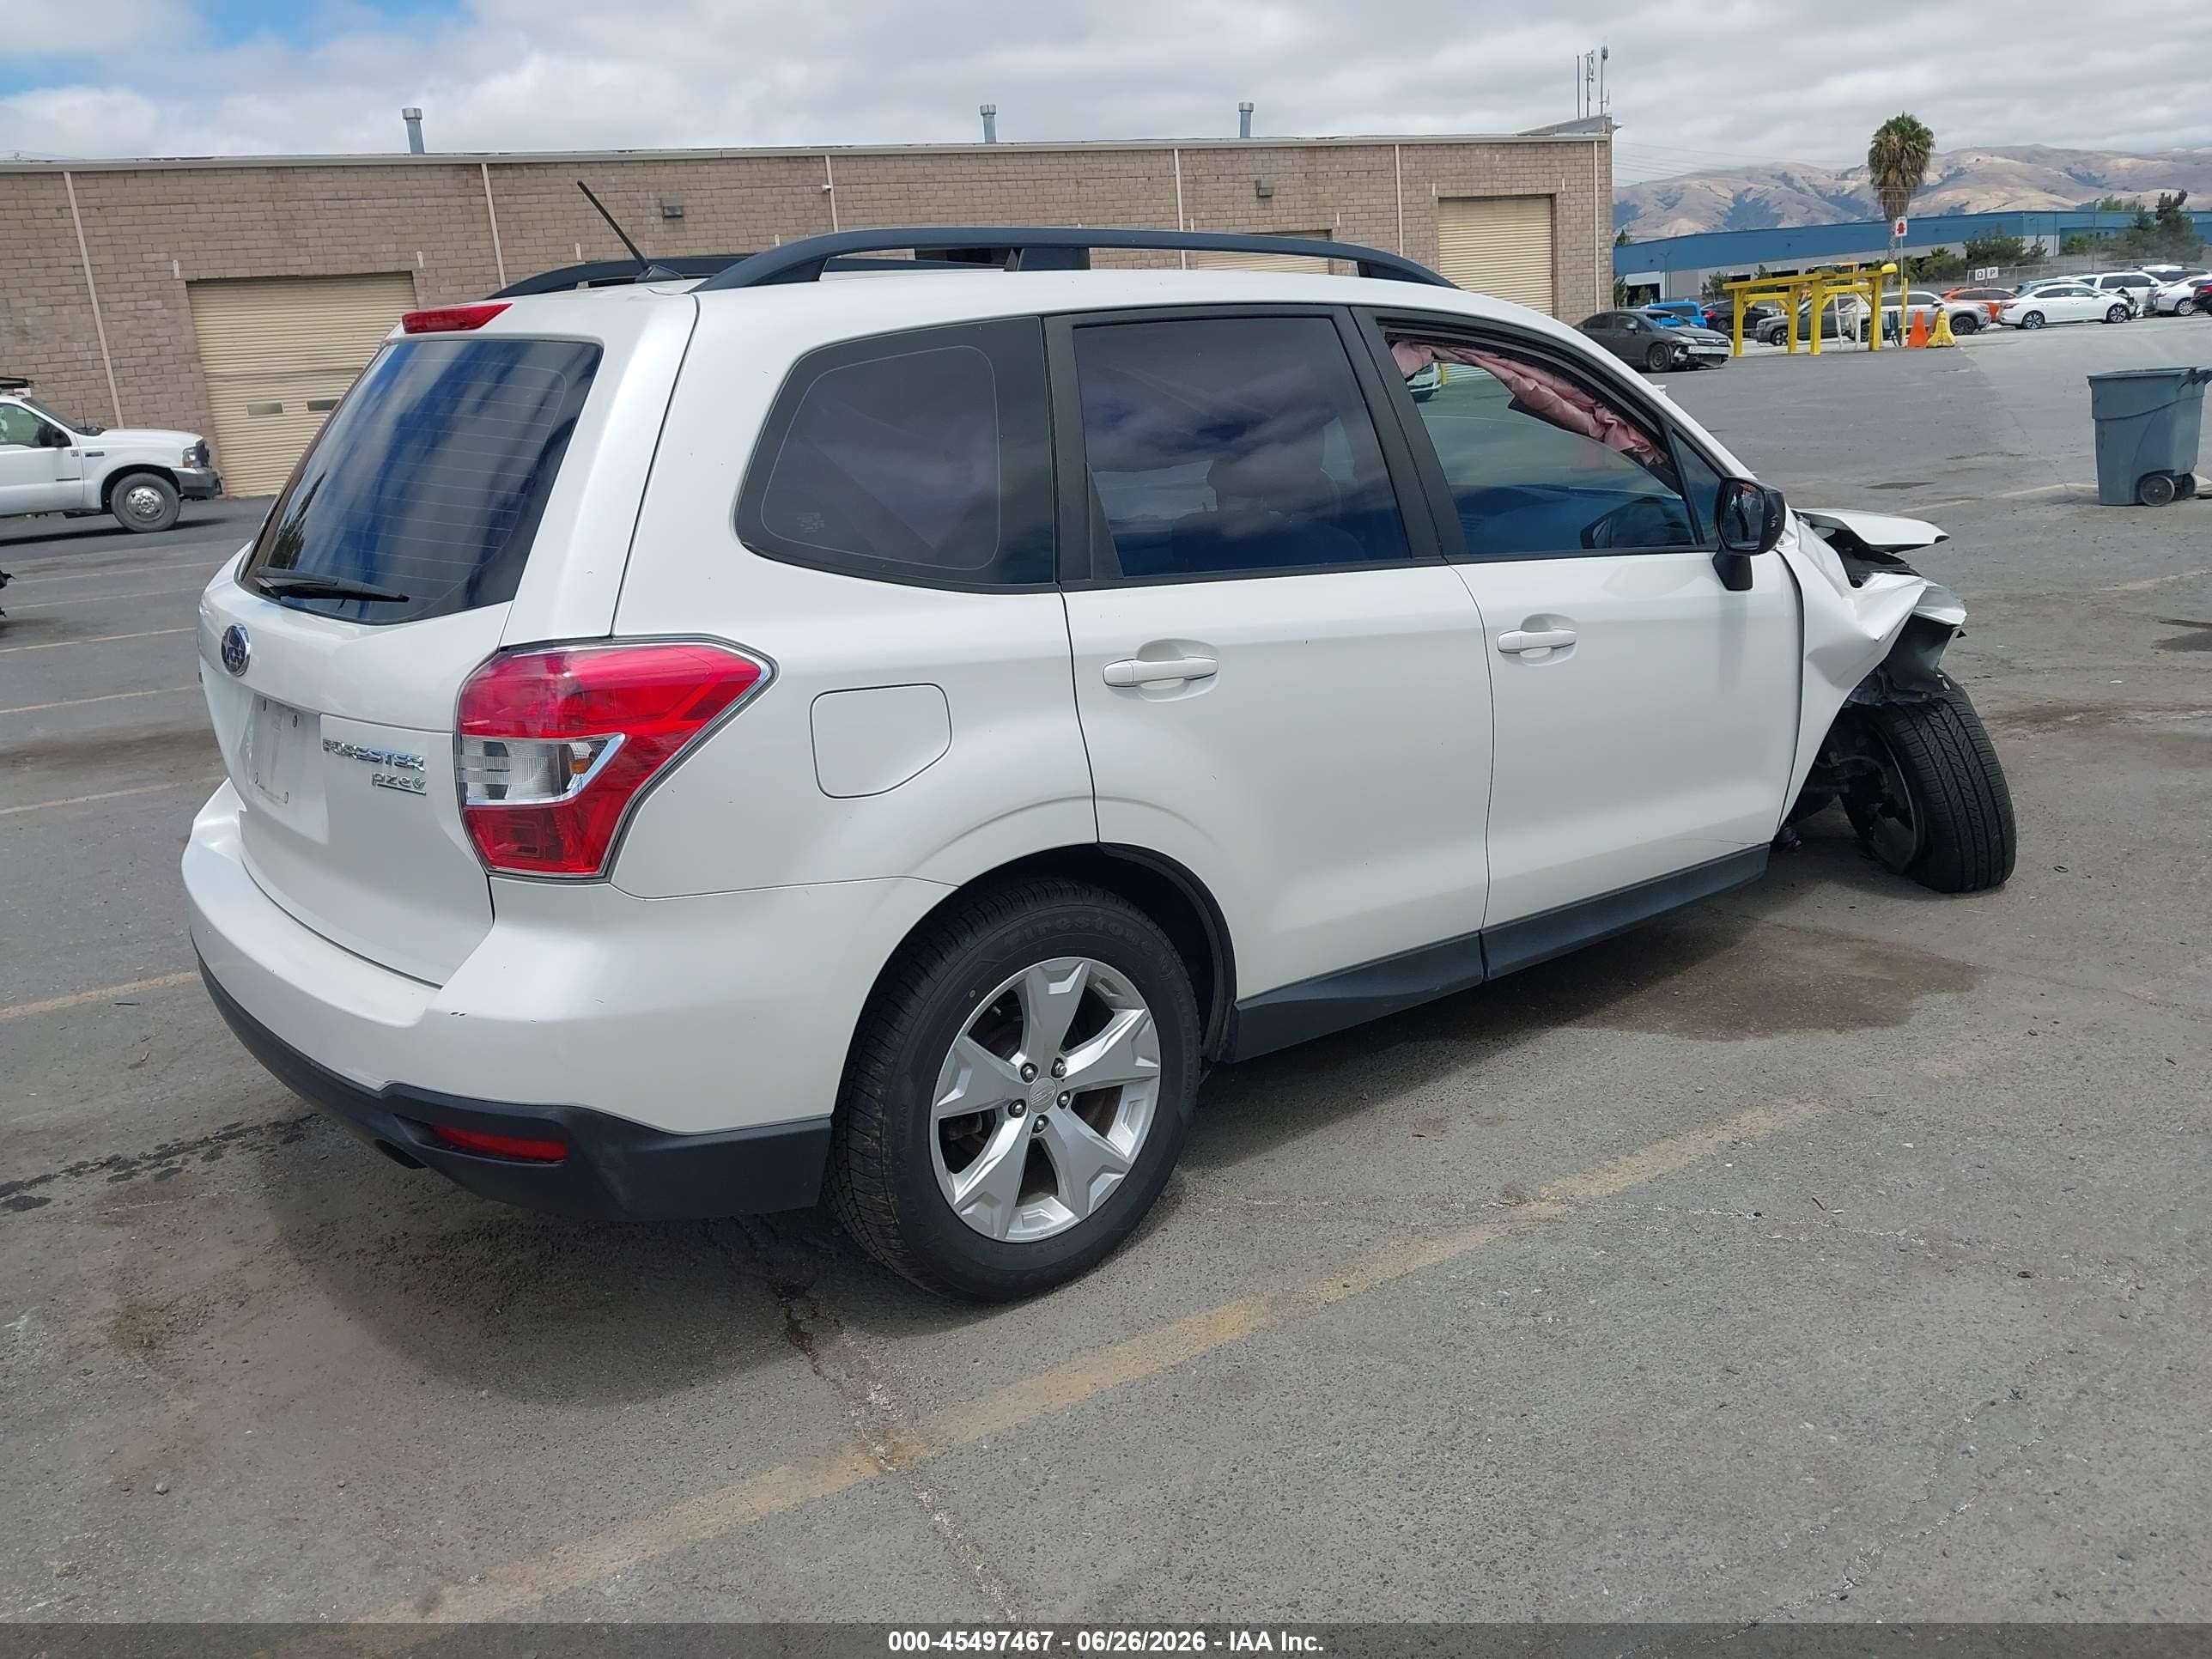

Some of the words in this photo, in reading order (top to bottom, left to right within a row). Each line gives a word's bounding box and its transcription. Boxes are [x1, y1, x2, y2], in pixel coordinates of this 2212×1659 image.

[1977, 270, 1984, 279] Q
[1990, 269, 1996, 277] P
[322, 737, 426, 773] FORESTER
